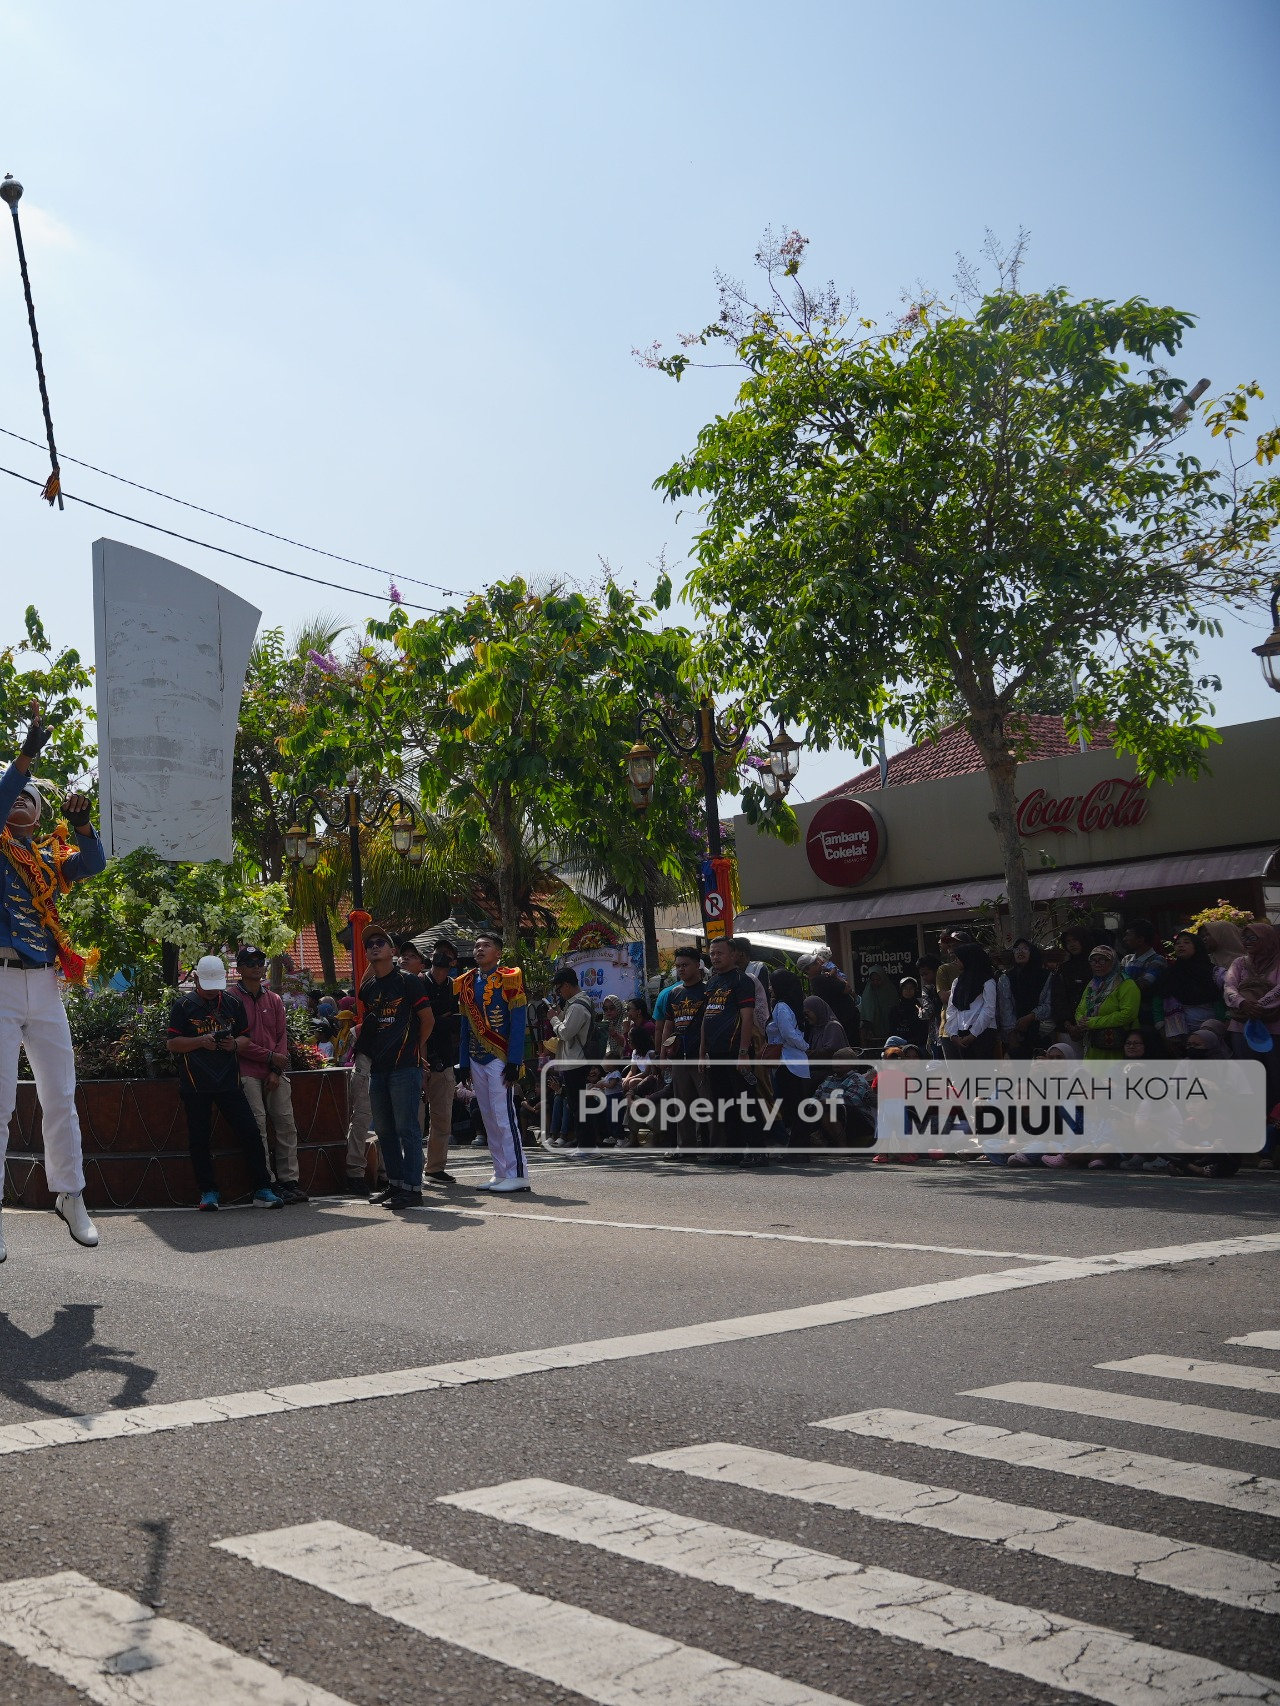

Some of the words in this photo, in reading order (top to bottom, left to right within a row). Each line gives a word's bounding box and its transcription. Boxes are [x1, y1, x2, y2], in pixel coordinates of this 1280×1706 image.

[808, 830, 870, 847] Tambang
[824, 843, 869, 860] Cokelat
[859, 950, 912, 964] Tambang
